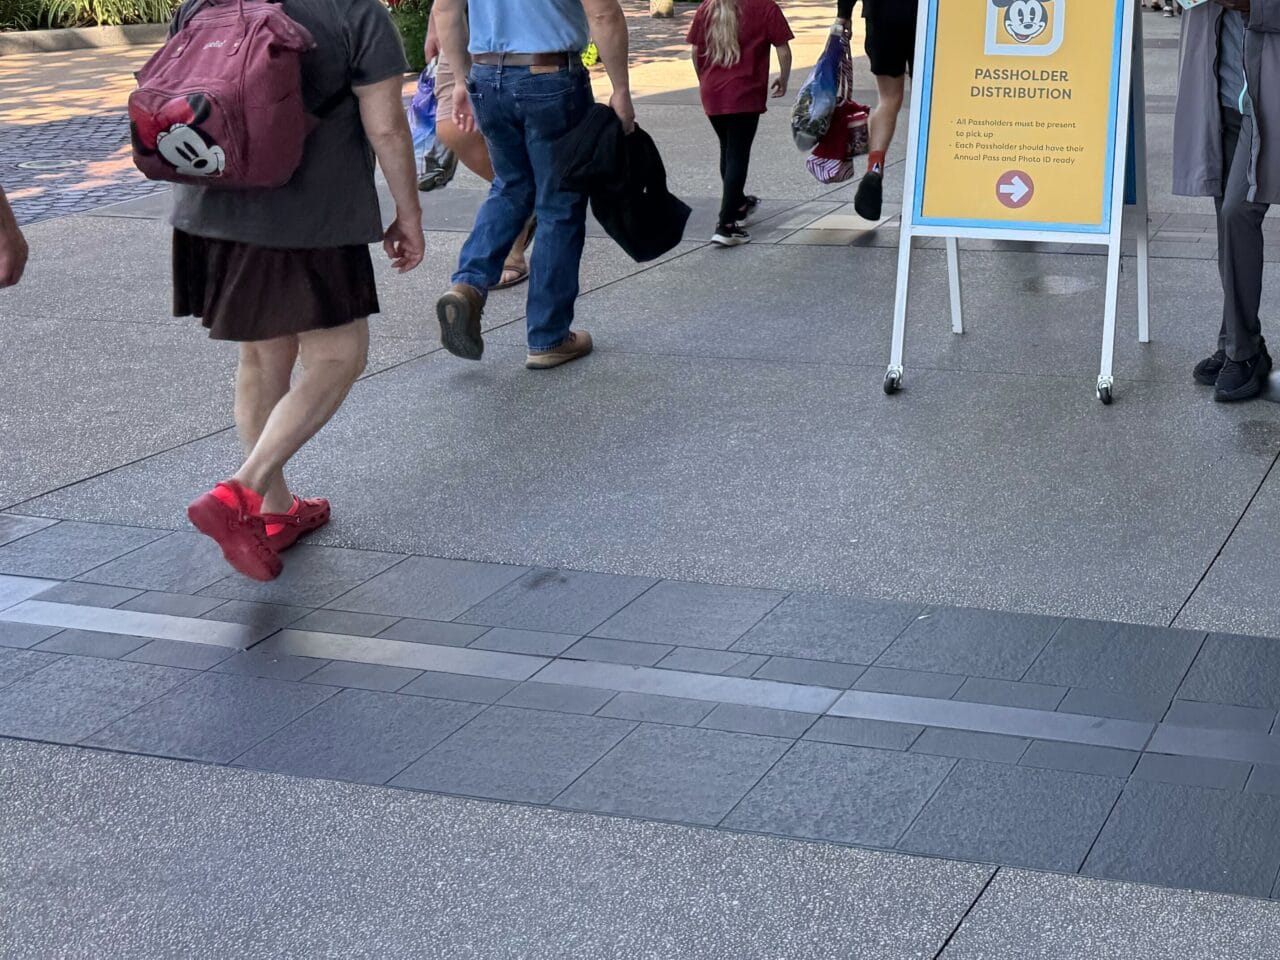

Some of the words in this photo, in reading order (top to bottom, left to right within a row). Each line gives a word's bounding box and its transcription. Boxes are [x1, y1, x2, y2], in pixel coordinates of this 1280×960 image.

[975, 68, 1069, 82] PASSHOLDER
[970, 86, 1072, 100] DISTRIBUTION
[956, 118, 967, 126] All
[968, 119, 1013, 127] Passholders
[1014, 120, 1034, 128] must
[1036, 120, 1045, 128] be
[1047, 121, 1076, 129] present
[966, 130, 982, 138] pick
[983, 131, 994, 139] up
[955, 141, 974, 149] Each
[976, 142, 1017, 150] Passholder
[1018, 143, 1044, 151] should
[1045, 144, 1064, 152] have
[1066, 144, 1084, 152] their
[953, 153, 981, 161] Annual
[982, 154, 1000, 162] Pass
[1001, 154, 1017, 162] and
[1018, 155, 1041, 163] Photo
[1052, 156, 1075, 165] ready
